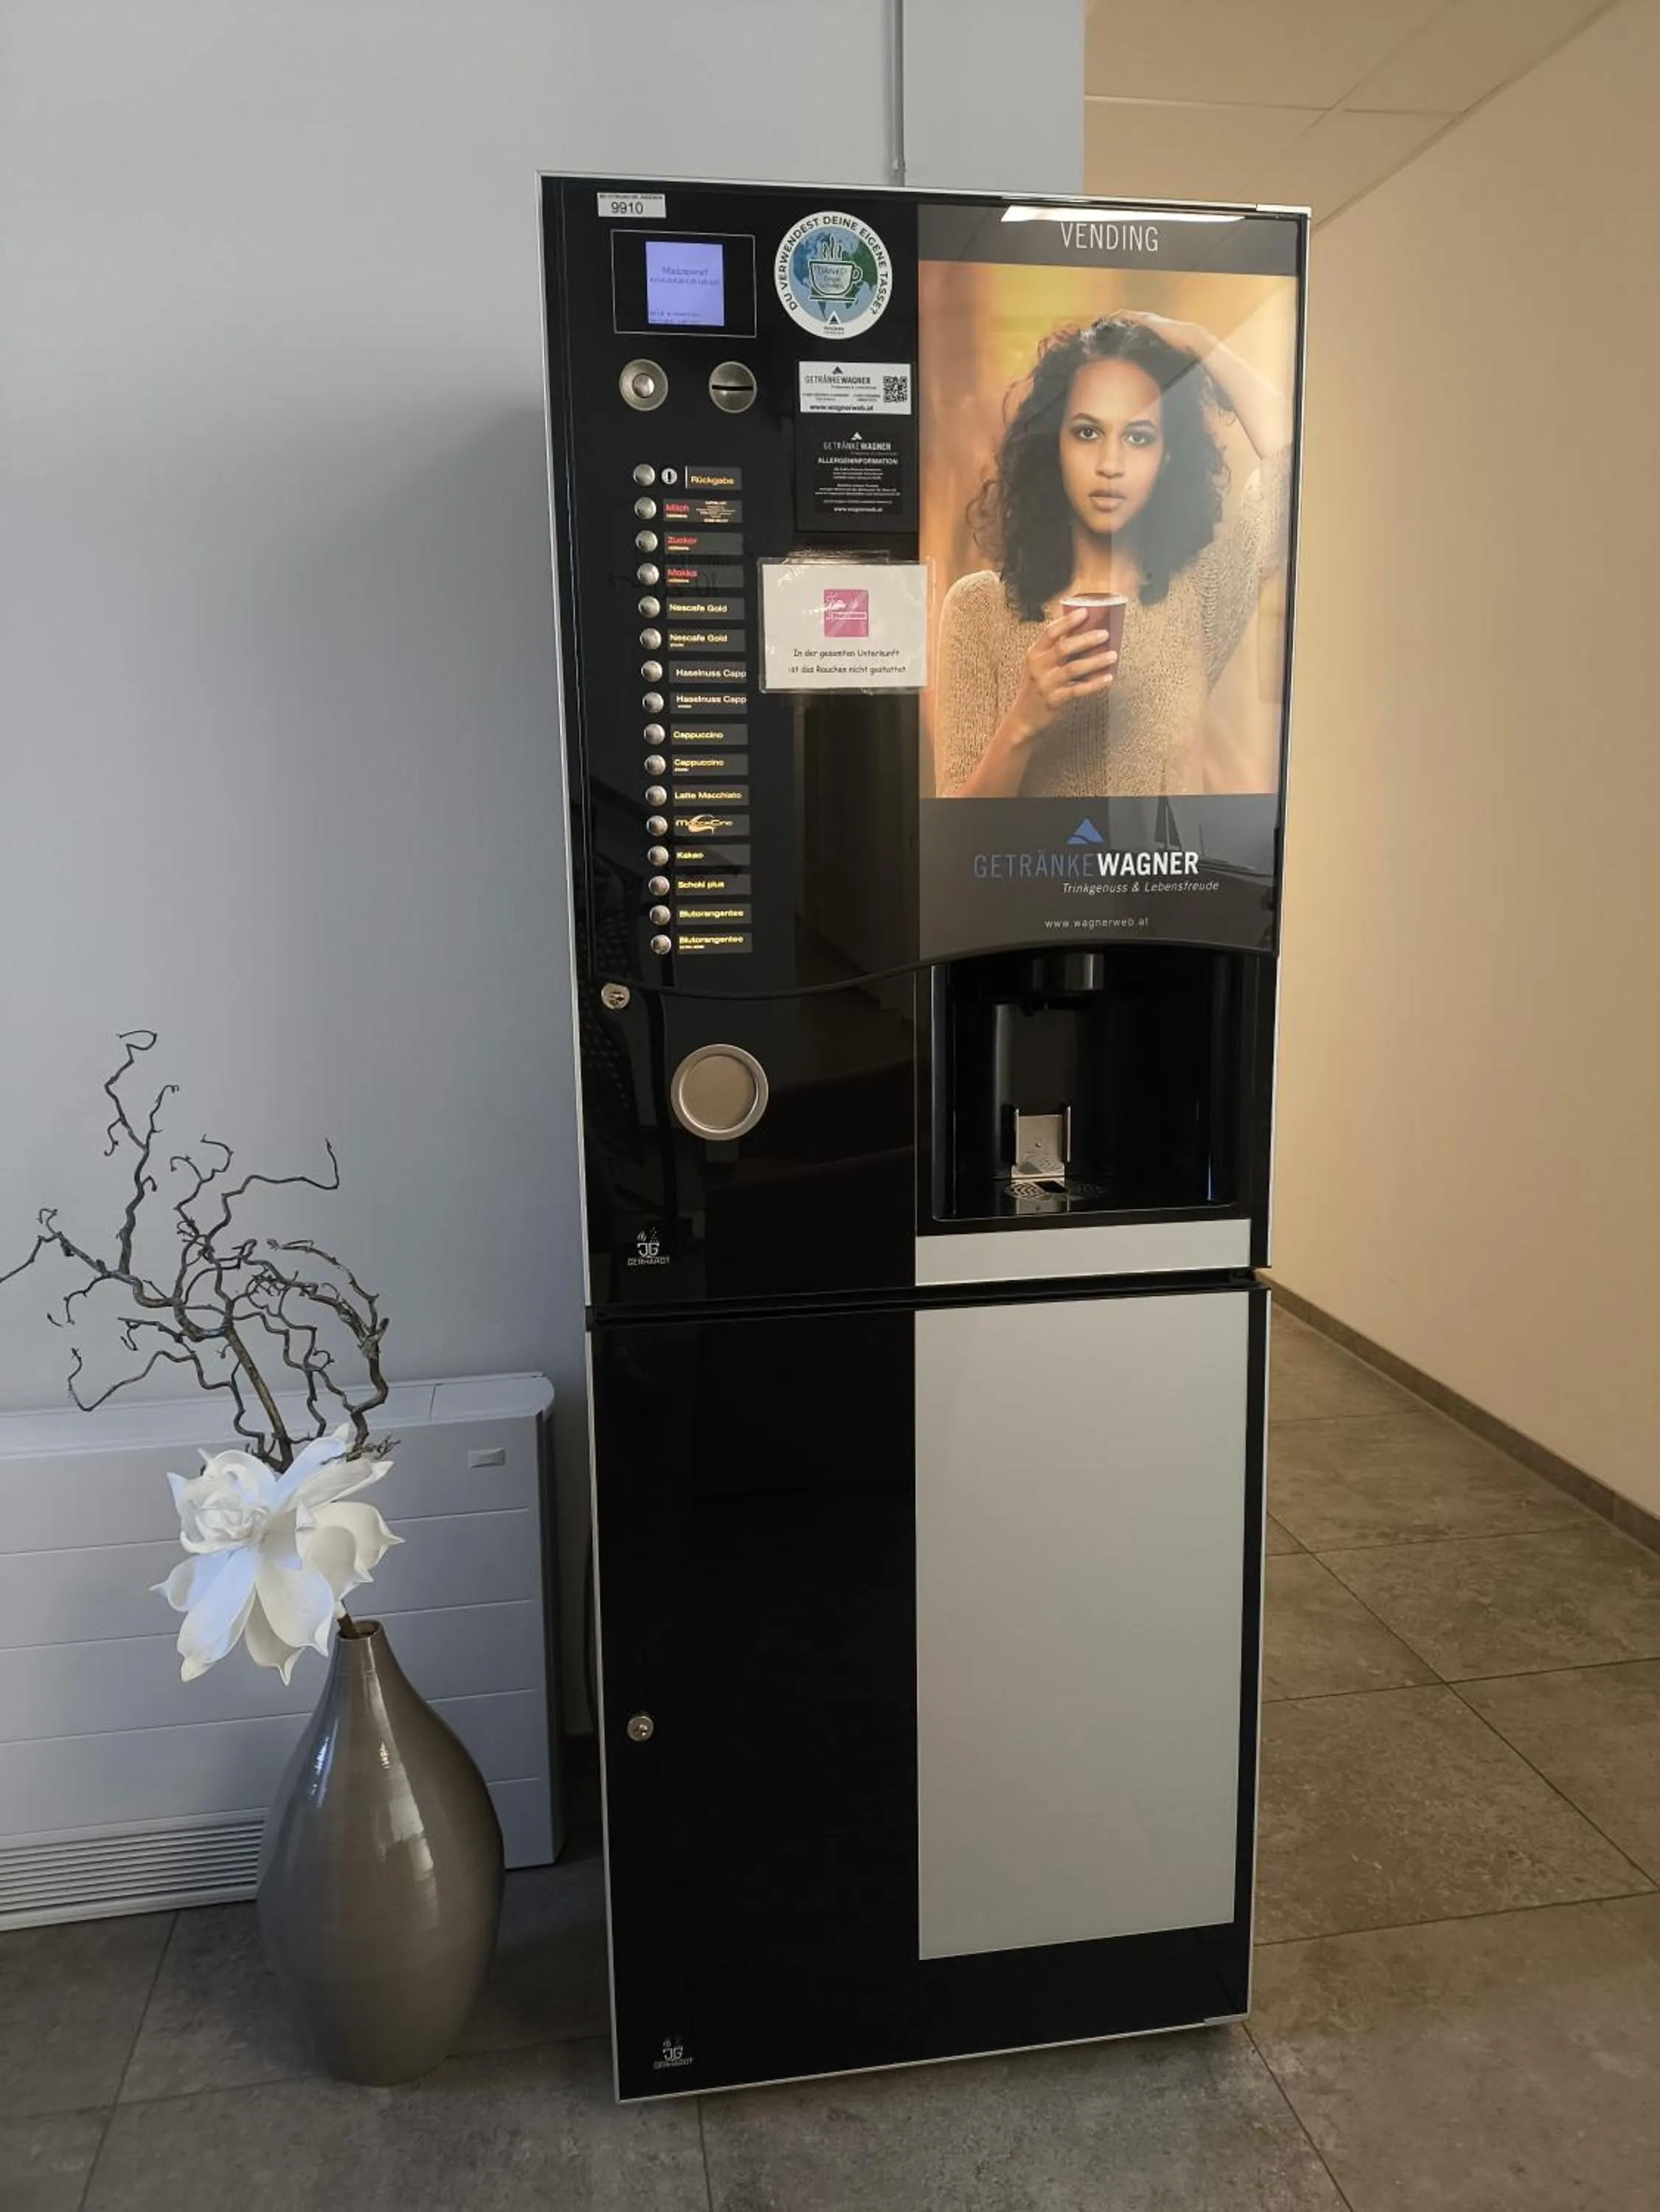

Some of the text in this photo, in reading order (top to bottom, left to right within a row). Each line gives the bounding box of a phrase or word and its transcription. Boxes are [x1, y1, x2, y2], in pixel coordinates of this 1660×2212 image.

[611, 201, 644, 215] 9910
[1060, 221, 1159, 252] VENDING
[778, 215, 888, 315] DU VERWENDEST DEINE EIGENE TASSE?
[690, 476, 735, 486] Rückgabe
[666, 504, 689, 512] Milch
[667, 536, 697, 544] Zucker
[667, 568, 698, 577] Mokka
[669, 604, 728, 613] Nescafe Gold
[669, 633, 728, 642] Nescafe Gold
[793, 649, 900, 660] In der gesamten Unterkunft
[788, 665, 799, 673] ist
[801, 665, 815, 673] das
[816, 665, 847, 673] Rauchen
[848, 664, 868, 673] nicht
[676, 669, 747, 678] Haselnuss Capp
[723, 695, 747, 704] Capp
[673, 731, 724, 740] Cappuccino
[674, 759, 725, 768] Cappuccino
[674, 791, 742, 799] Latte Macchiato
[707, 881, 725, 890] plus
[1062, 880, 1220, 896] Trinkgenuss & Lebensfreude
[679, 910, 744, 918] Blutorangentee
[679, 936, 744, 945] Blutorangentee
